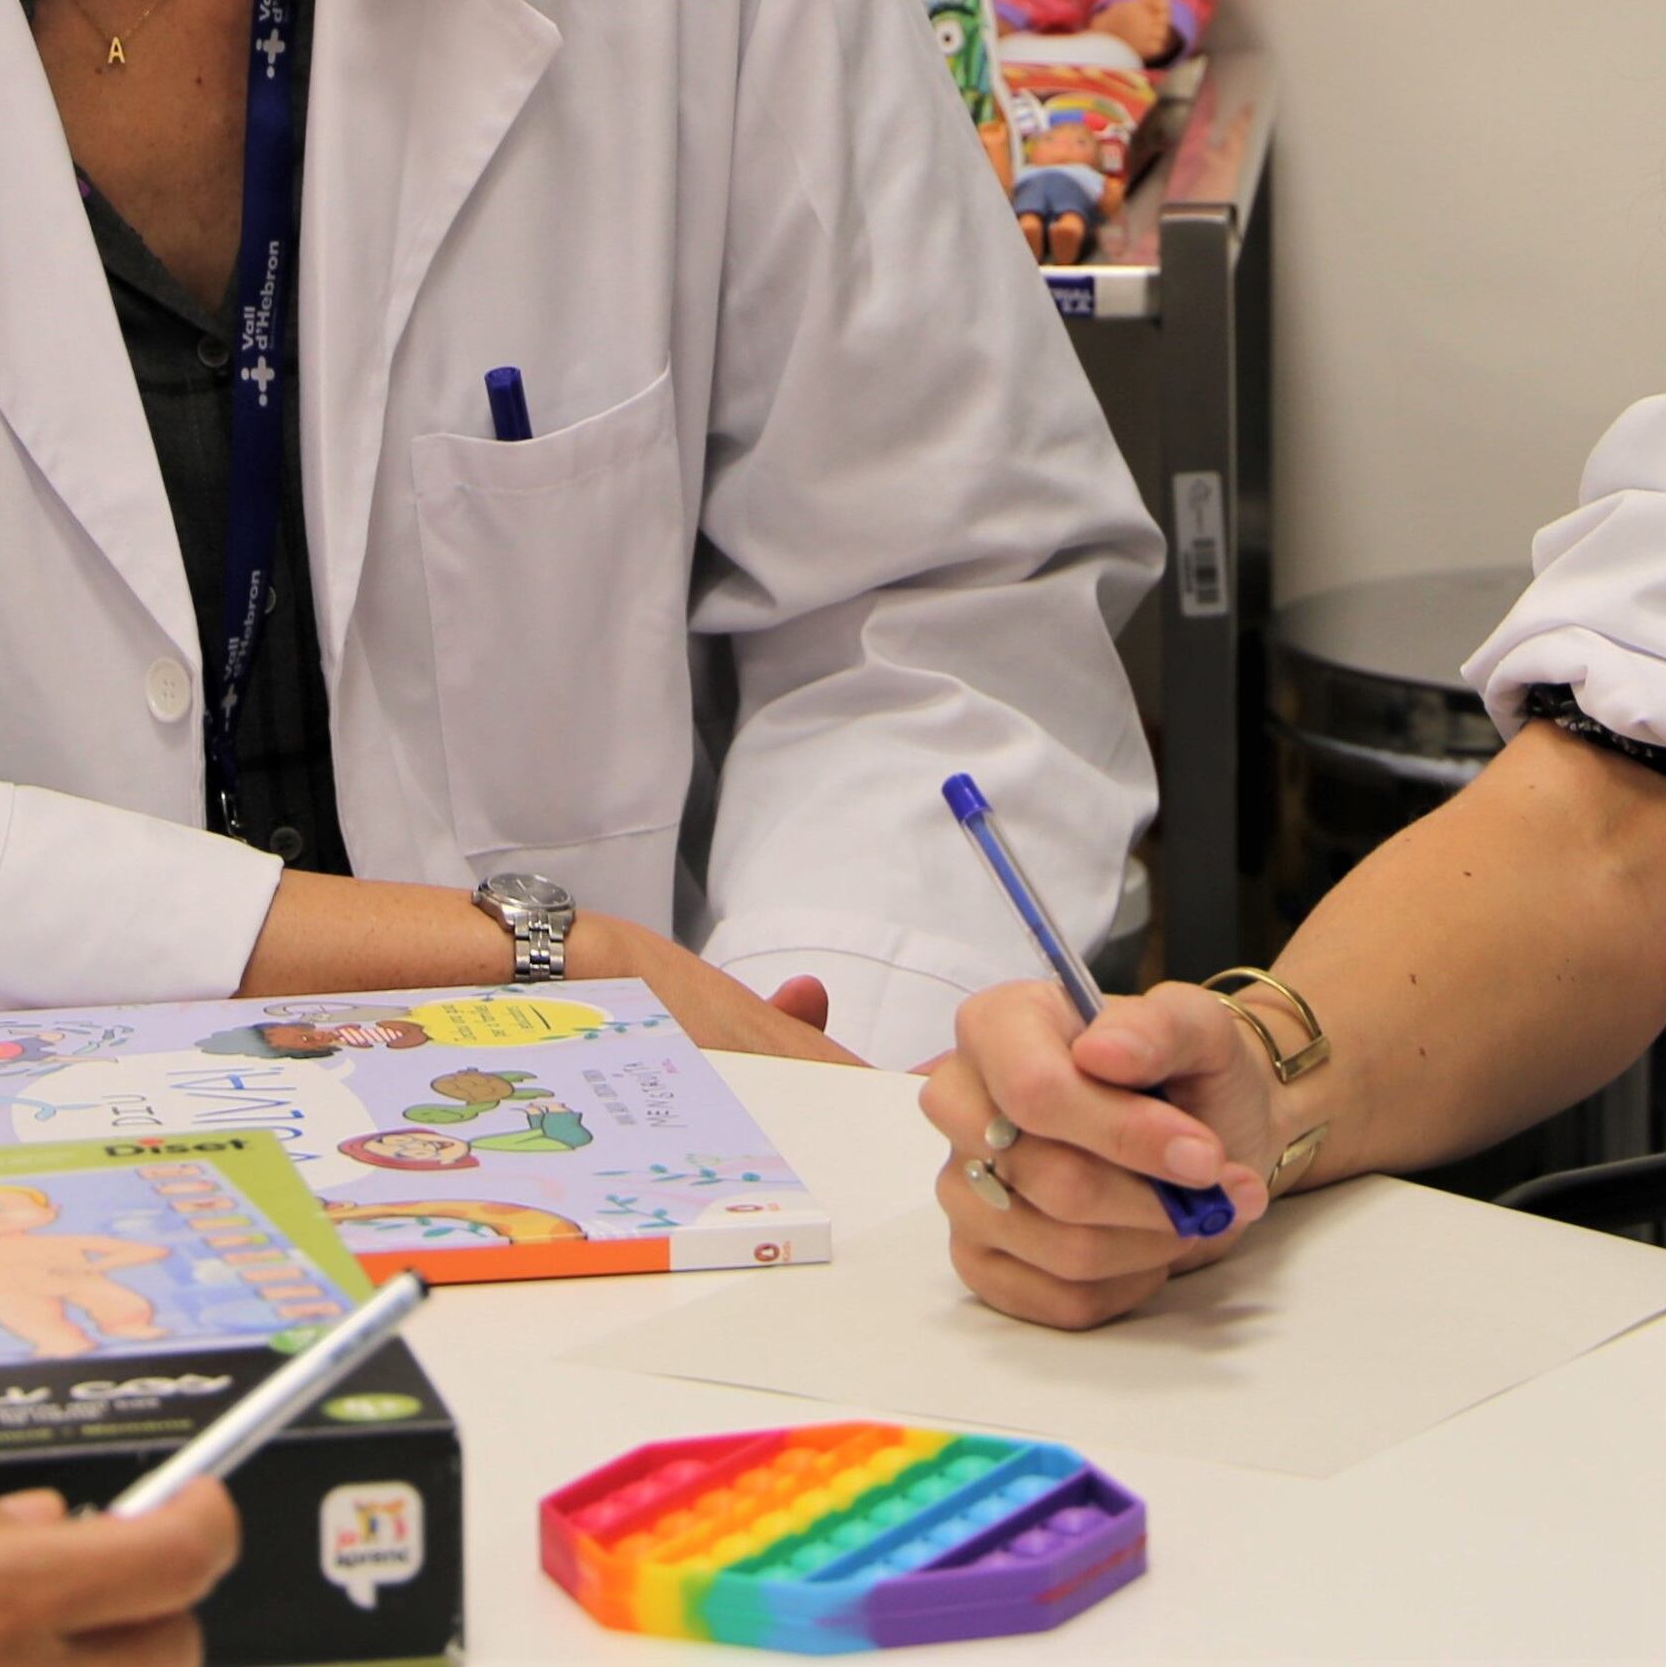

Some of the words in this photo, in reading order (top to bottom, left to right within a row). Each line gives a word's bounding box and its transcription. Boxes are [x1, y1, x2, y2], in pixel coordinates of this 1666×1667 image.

[107, 36, 126, 64] A
[256, 240, 280, 351] d'Hebron
[242, 305, 255, 350] Vall
[104, 1136, 249, 1157] Diset
